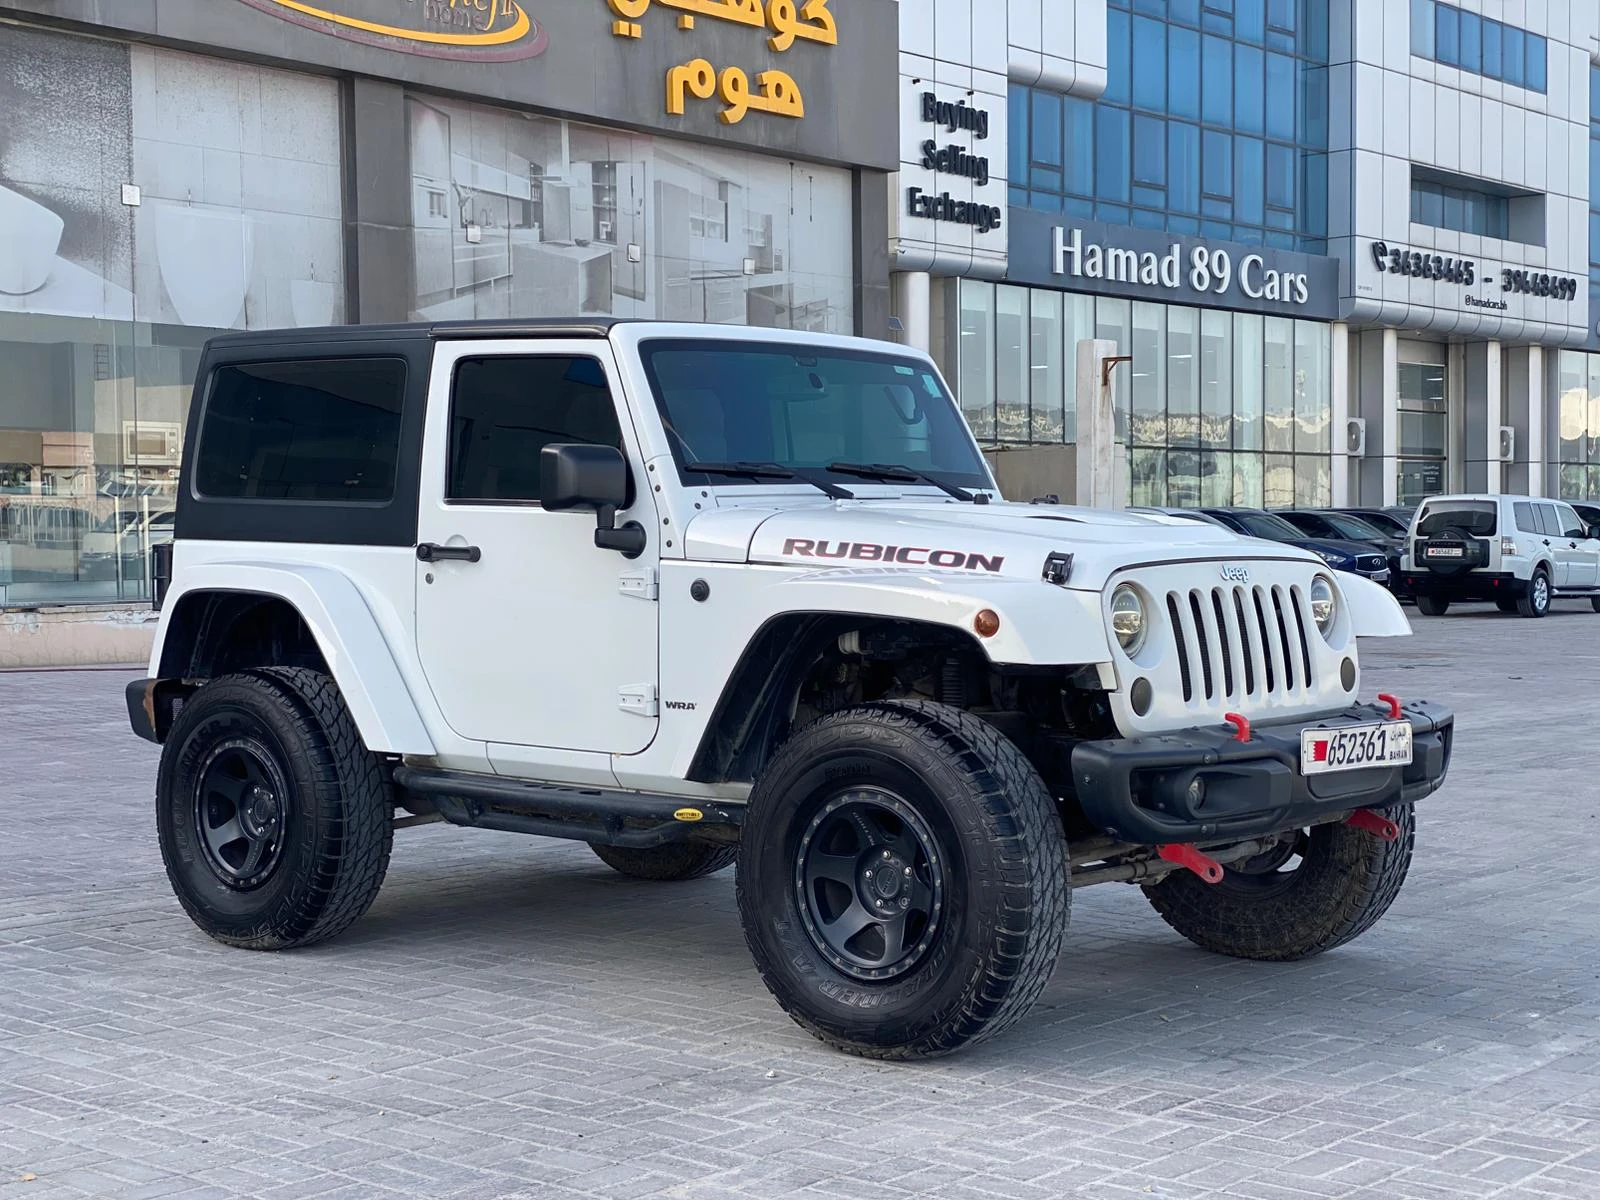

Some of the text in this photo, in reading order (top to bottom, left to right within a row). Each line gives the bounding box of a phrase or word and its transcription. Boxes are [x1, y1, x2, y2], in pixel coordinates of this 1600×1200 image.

[666, 59, 805, 124] هوم
[921, 92, 989, 139] Buying
[921, 139, 989, 186] Selling
[907, 187, 1001, 233] Exchange
[1052, 226, 1309, 304] Hamad 89 Cars
[782, 538, 1005, 572] RUBICON
[1219, 563, 1249, 584] Jeep
[1327, 729, 1387, 766] 652361
